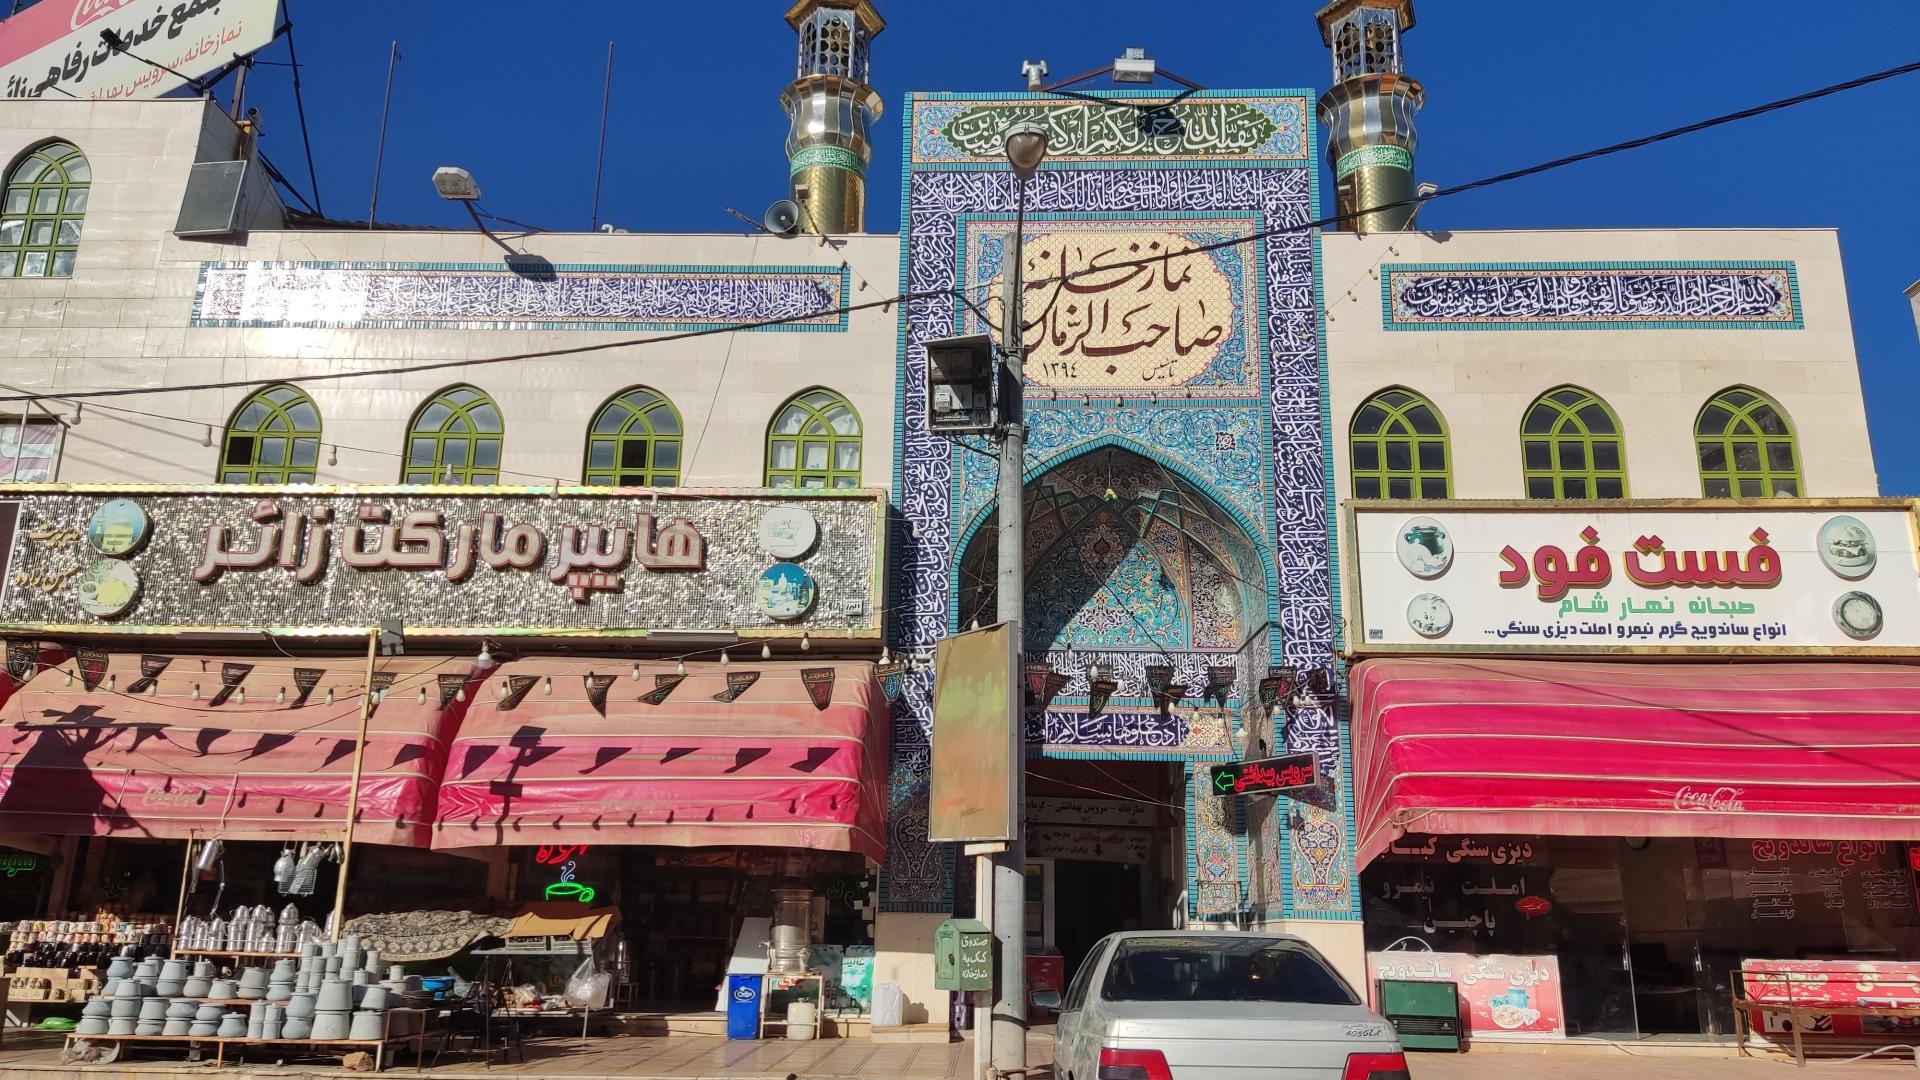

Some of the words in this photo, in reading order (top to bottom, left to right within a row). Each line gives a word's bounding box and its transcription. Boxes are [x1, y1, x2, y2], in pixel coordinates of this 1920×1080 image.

[193, 500, 334, 585] زائر
[341, 504, 543, 582] مارکت
[549, 512, 706, 602] هایپر
[1499, 525, 1612, 602] فود
[1625, 527, 1782, 587] فست
[1558, 591, 1609, 619] شام
[1619, 596, 1676, 621] نهار
[1688, 596, 1756, 619] صبحانه
[1542, 622, 1577, 640] دیزی
[1579, 621, 1613, 636] املت
[1618, 621, 1654, 641] نیمرو
[1658, 621, 1688, 639] گرم
[1691, 621, 1750, 640] ساندویچ
[1752, 622, 1788, 641] انواع
[1234, 763, 1276, 792] بهداشتی
[1276, 763, 1314, 786] سرویس
[1672, 785, 1745, 811] Coca-Cola
[1445, 838, 1490, 864] سنگی
[1491, 841, 1534, 866] دیزی
[1381, 874, 1436, 900] نیمرو
[1460, 874, 1527, 896] املت
[1423, 908, 1497, 937] پاچین
[961, 935, 989, 948] صندوق
[1462, 960, 1506, 986] سنگی
[1509, 961, 1550, 987] دیزی
